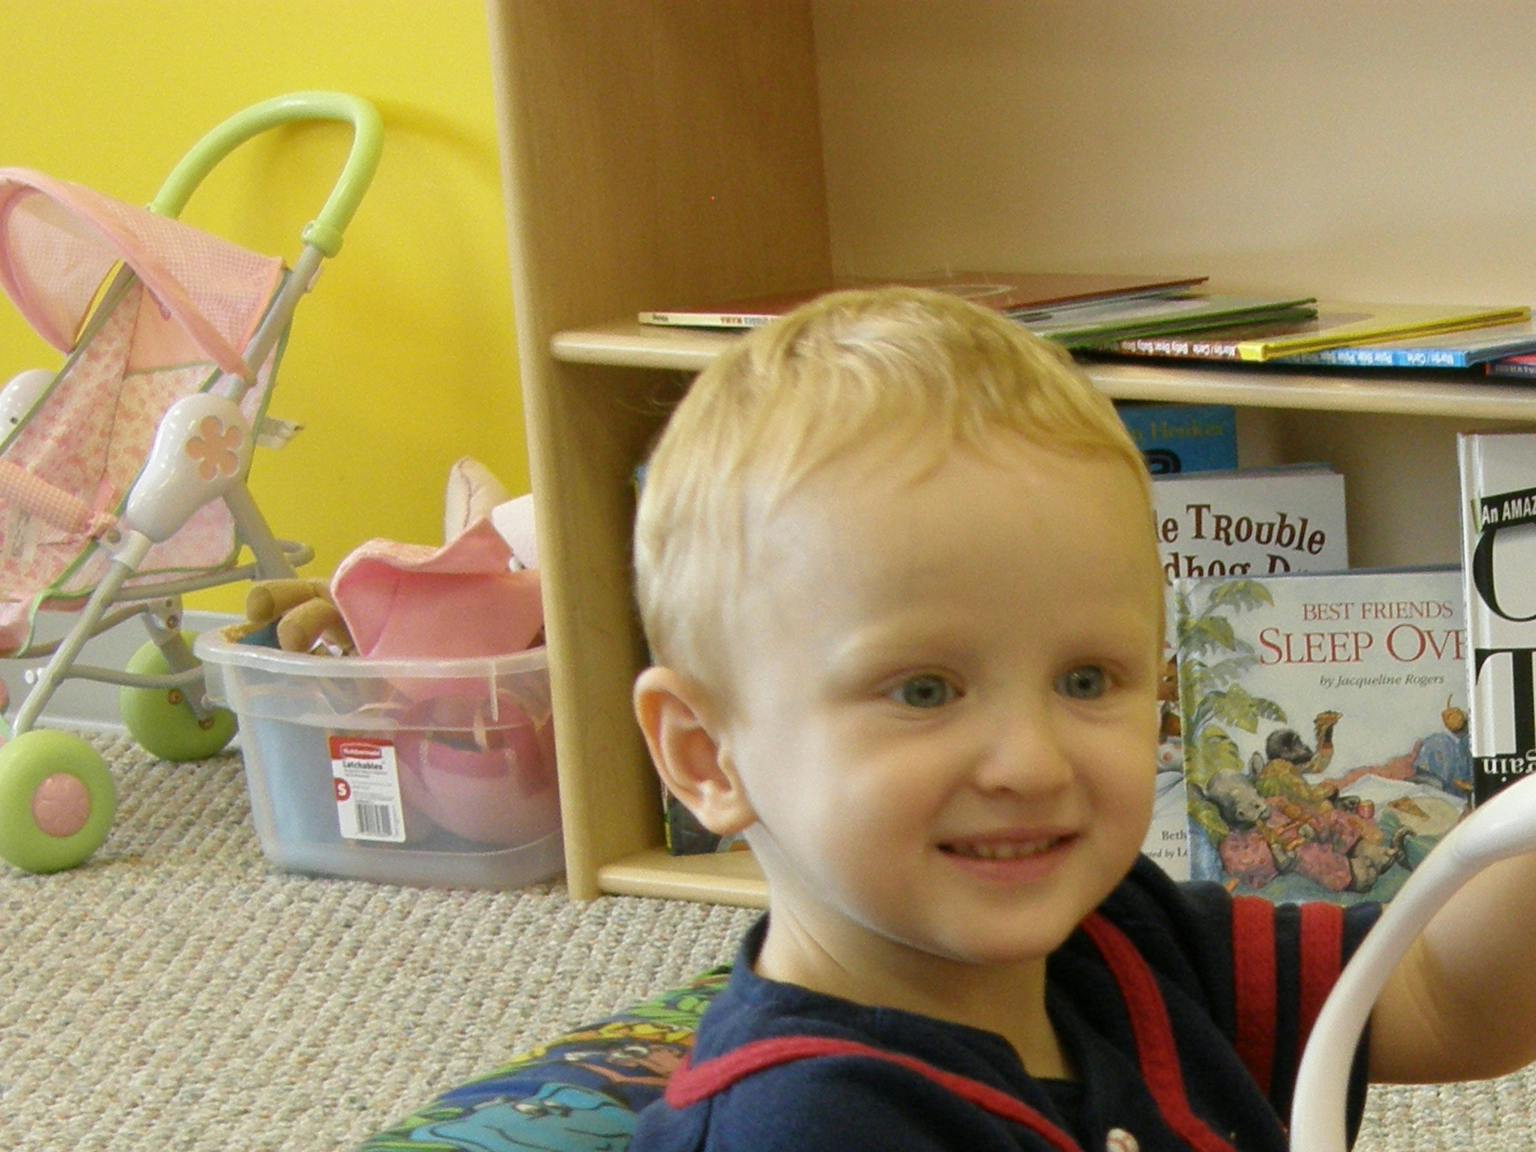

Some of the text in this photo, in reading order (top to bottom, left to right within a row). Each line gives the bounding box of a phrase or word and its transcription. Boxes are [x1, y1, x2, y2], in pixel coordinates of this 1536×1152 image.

[1482, 504, 1499, 525] An
[1302, 600, 1454, 621] BEST FRIENDS
[1258, 623, 1466, 665] SLEEP OVE
[1319, 674, 1445, 688] by Jacqueline Rogers
[337, 783, 347, 796] S
